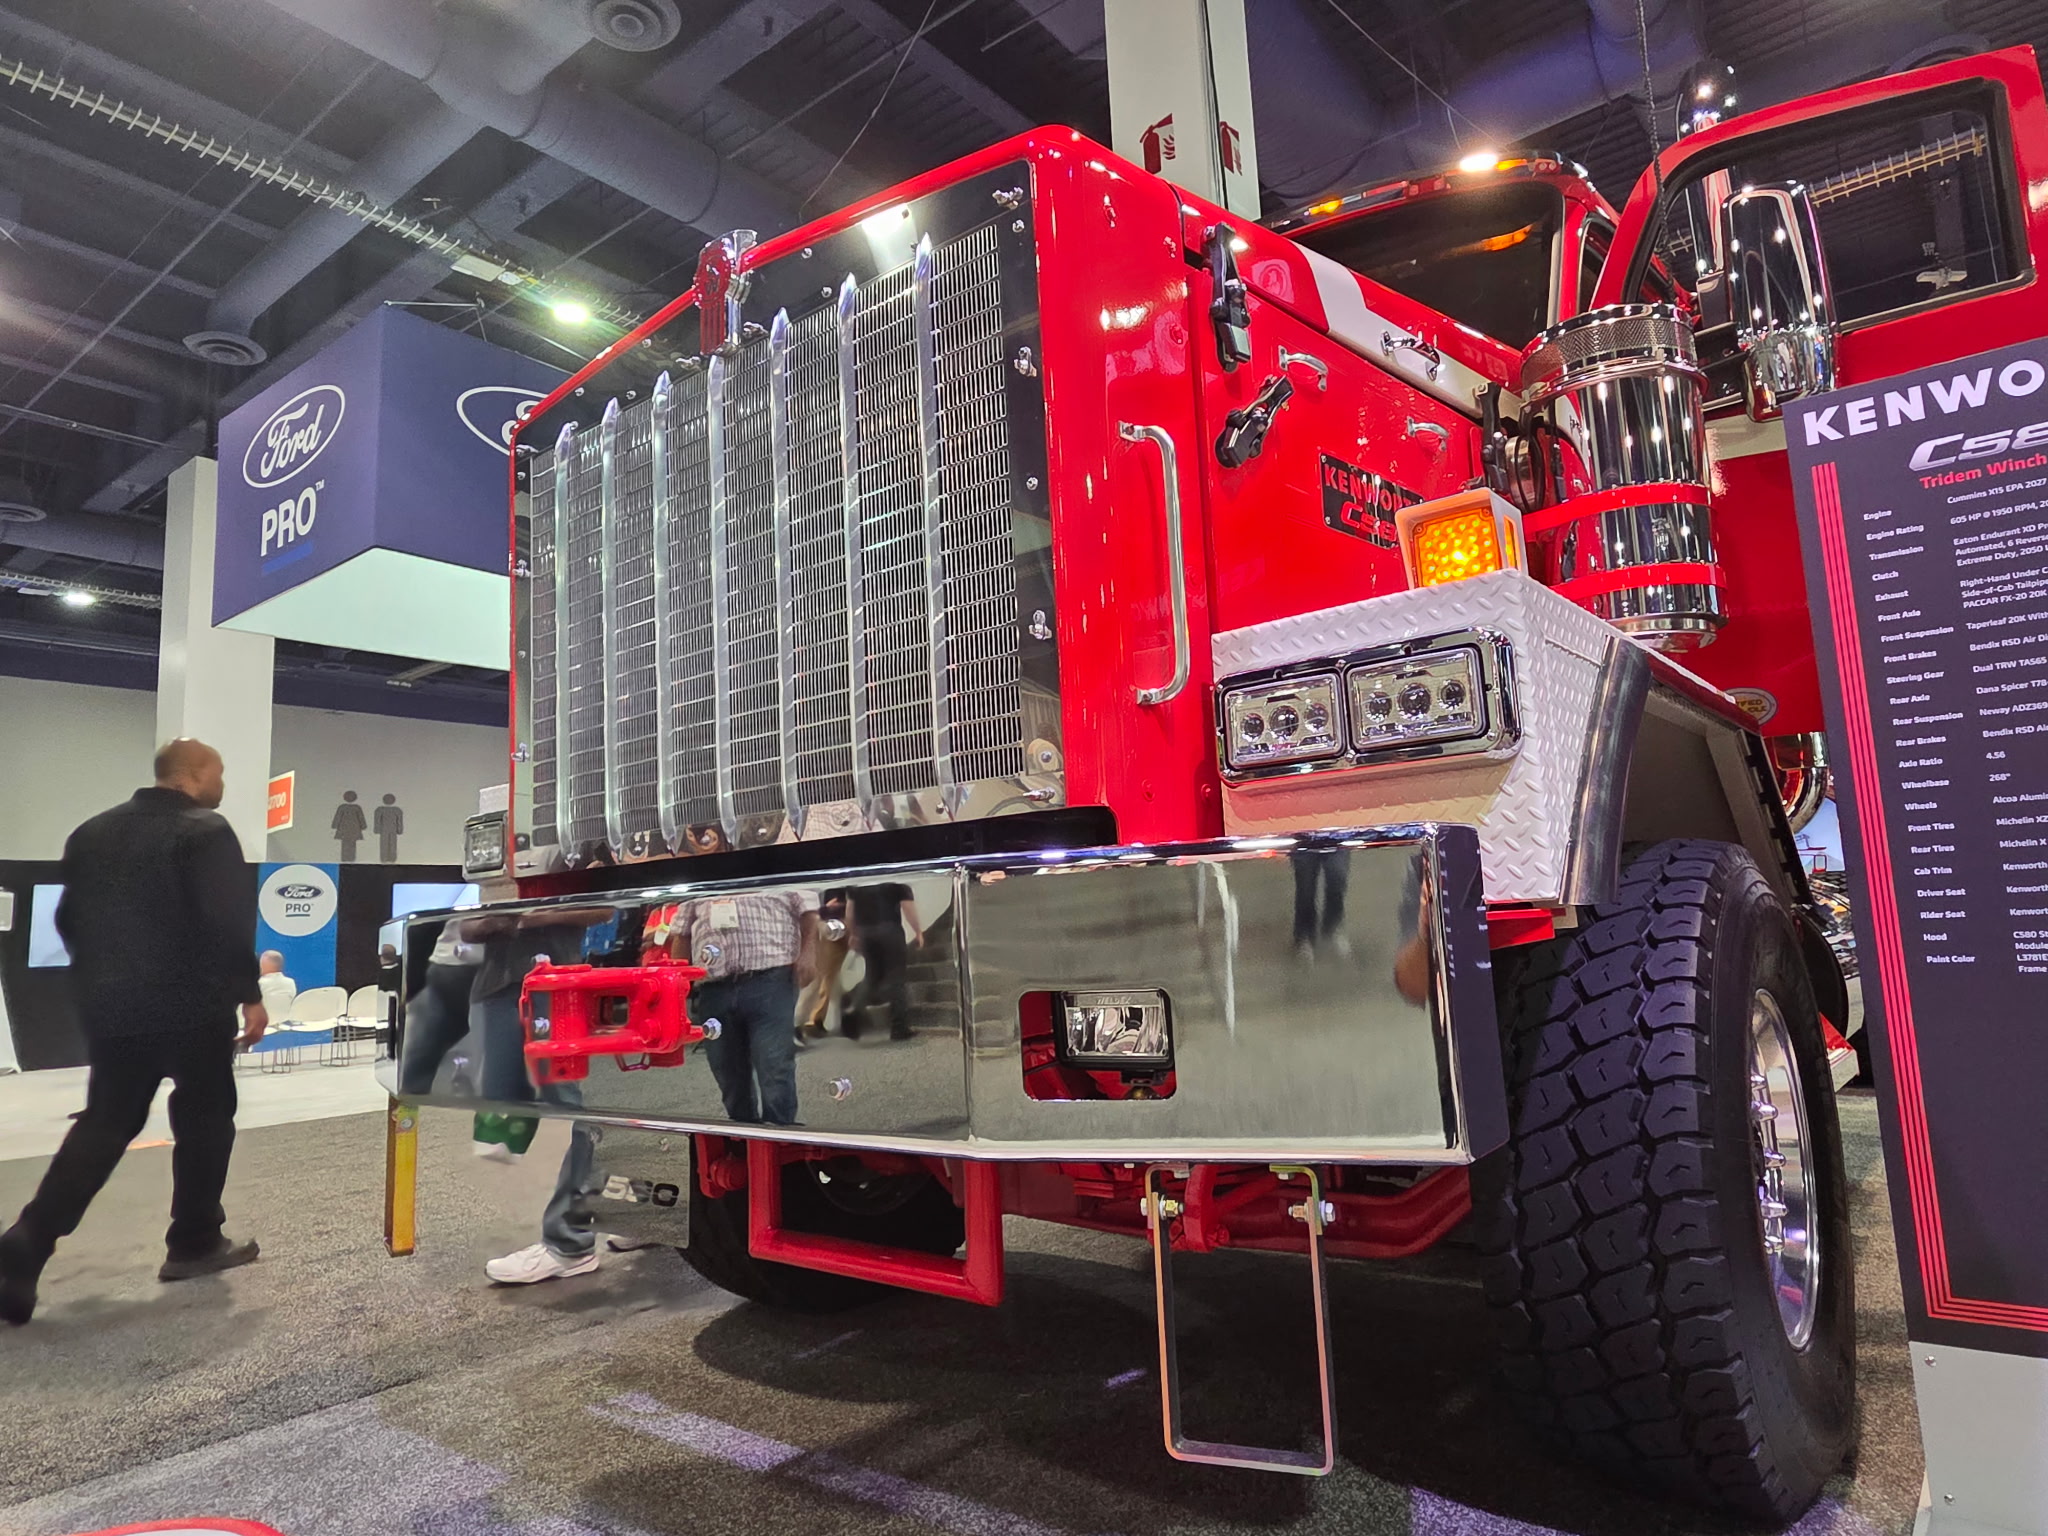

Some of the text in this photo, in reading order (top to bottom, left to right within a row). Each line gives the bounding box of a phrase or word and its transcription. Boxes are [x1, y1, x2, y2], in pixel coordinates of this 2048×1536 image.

[260, 402, 325, 478] Ford
[1919, 453, 2047, 489] Tridem Winch
[1324, 463, 1413, 512] KENWOR
[1947, 478, 2047, 504] Cummins X15 EPA 2027
[1863, 509, 1892, 521] Engine
[1950, 515, 1967, 525] 605
[1968, 512, 1982, 521] HP
[1991, 507, 2013, 517] 1950
[2014, 502, 2038, 513] RPM,
[260, 487, 317, 557] PRO
[1340, 501, 1398, 541] C58
[1866, 523, 1924, 541] Engine Rating
[1953, 534, 1979, 546] Eaton
[1980, 527, 2021, 541] Endurant
[2022, 524, 2036, 533] XD
[1869, 545, 1924, 561] Transmission
[1955, 541, 2006, 556] Automated,
[2007, 539, 2014, 547] 6
[1956, 555, 1993, 567] Extreme
[1994, 551, 2019, 561] Duty,
[2020, 545, 2043, 556] 2050
[1872, 570, 1899, 582] Clutch
[1959, 572, 2011, 588] Right-Hand
[2012, 568, 2040, 579] Under
[1875, 589, 1909, 602] Exhaust
[1961, 584, 2014, 598] Side-of-Cab
[1963, 589, 2047, 609] PACCAR FX-20 20K
[1878, 609, 1921, 622] Front Axle
[1966, 617, 2007, 631] Taperleaf
[2008, 614, 2027, 624] 20K
[1881, 625, 1954, 643] Front Suspension
[1969, 640, 2000, 651] Bendix
[2001, 637, 2021, 647] RSD
[2022, 635, 2036, 644] Air
[1884, 649, 1937, 663] Front Brakes
[1972, 656, 2047, 673] Dual TRW TAS65
[1886, 670, 1945, 685] Steering Gear
[1976, 685, 2000, 695] Dana
[2001, 681, 2029, 692] Spicer
[1889, 693, 1930, 705] Rear Axle
[1979, 706, 2010, 717] Neway
[1893, 712, 1963, 726] Rear Suspension
[1983, 727, 2014, 738] Bendix
[2015, 725, 2035, 734] RSD
[1896, 735, 1946, 747] Rear Brakes
[1986, 750, 2006, 760] 4.56
[1899, 757, 1943, 768] Axle Ratio
[1901, 778, 1950, 790] Wheelbase
[1904, 801, 1937, 811] Wheels
[1992, 795, 2018, 804] Alcoa
[1908, 822, 1955, 832] Front Tires
[1996, 817, 2034, 826] Michelin
[1911, 843, 1955, 854] Rear Tires
[1999, 838, 2047, 848] Michelin X
[1914, 865, 1952, 876] Cab Trim
[2003, 861, 2048, 871] Kenworth
[284, 884, 314, 899] Ford
[1917, 887, 1966, 898] Driver Seat
[285, 903, 311, 913] PRO
[1920, 909, 1966, 919] Rider Seat
[1923, 932, 1947, 941] Hood
[2013, 930, 2037, 939] C580
[1926, 954, 1975, 964] Paint Color
[2016, 953, 2048, 962] L3781E
[2018, 965, 2048, 973] Frame
